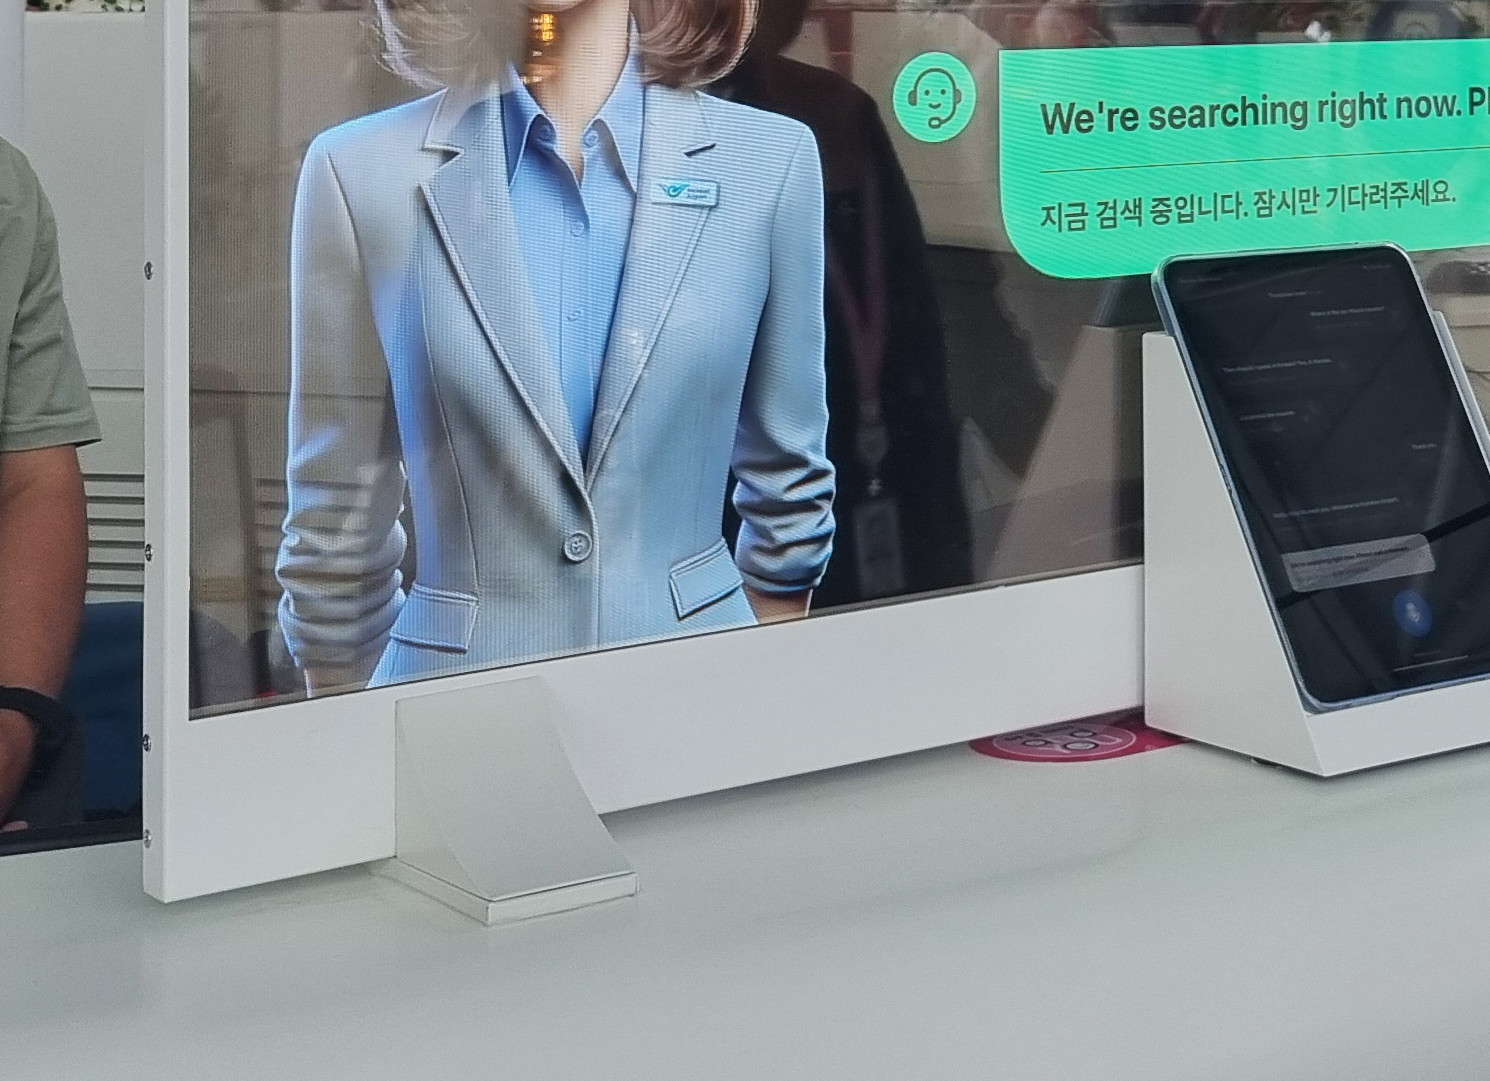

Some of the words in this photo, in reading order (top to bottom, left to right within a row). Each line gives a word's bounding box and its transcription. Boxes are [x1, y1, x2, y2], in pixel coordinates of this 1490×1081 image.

[1040, 101, 1139, 136] We're
[1148, 93, 1308, 132] searching
[1317, 91, 1388, 129] right
[1395, 93, 1462, 119] now.
[1040, 201, 1090, 233] 지금
[1096, 197, 1144, 230] 검색
[1150, 190, 1249, 225] 중입니다.
[1253, 185, 1320, 218] 잠시만
[1325, 178, 1457, 213] 기다려주세요.
